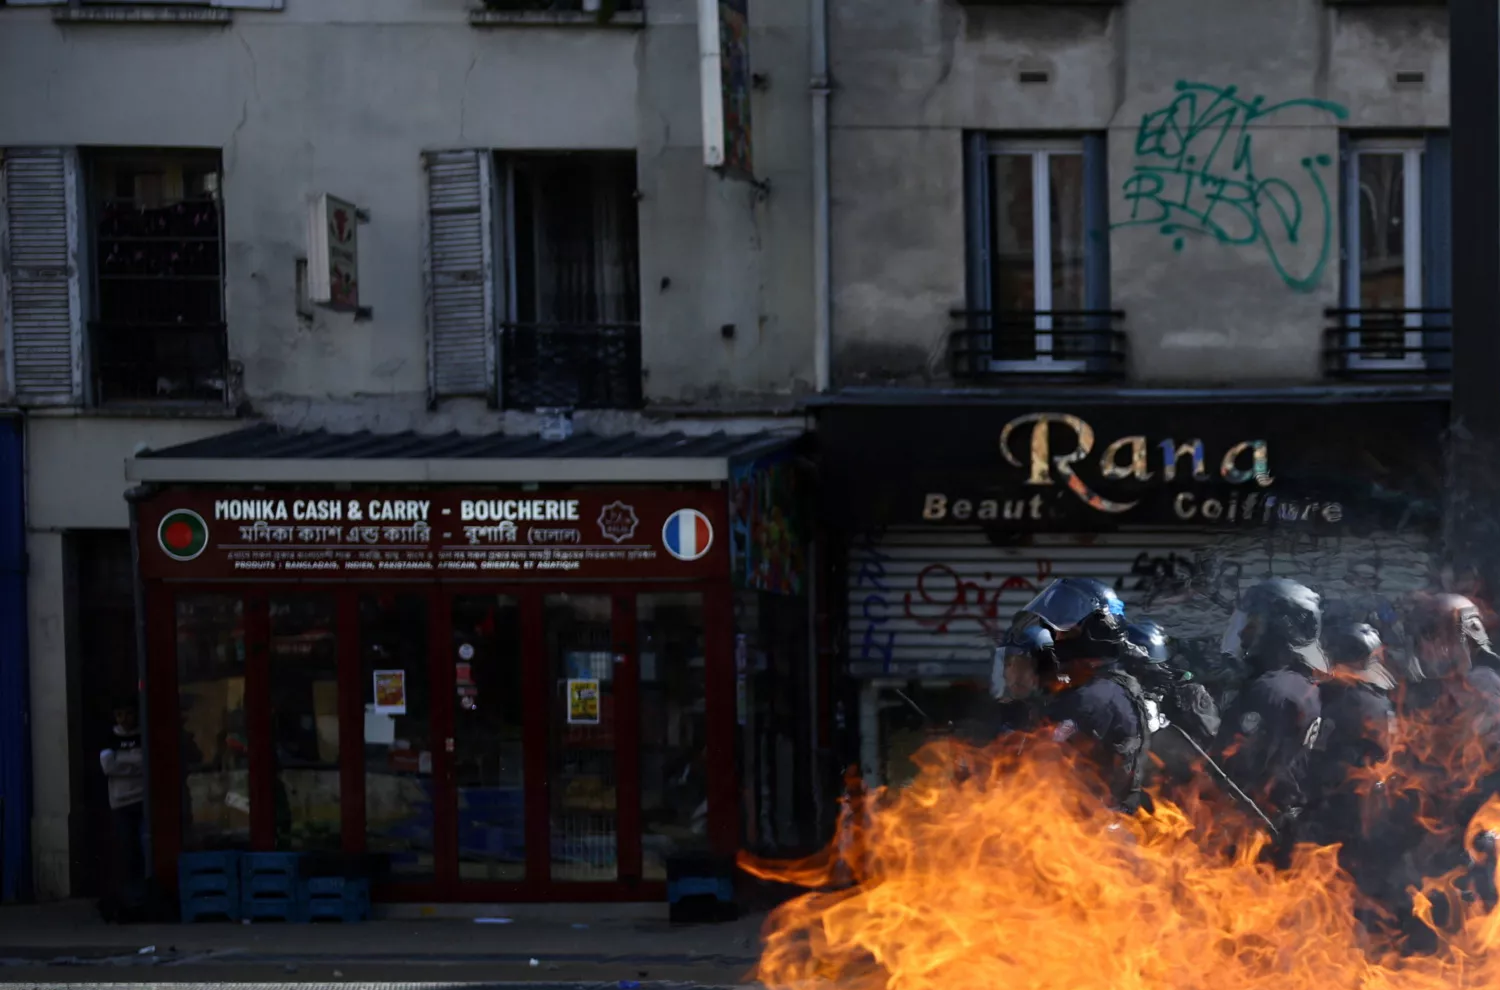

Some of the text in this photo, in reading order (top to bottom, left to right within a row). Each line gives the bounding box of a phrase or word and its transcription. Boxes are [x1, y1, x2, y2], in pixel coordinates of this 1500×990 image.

[999, 411, 1275, 514] Rana
[214, 499, 289, 521] MONIKA
[292, 499, 342, 521] CASH
[347, 499, 364, 521] &
[368, 499, 431, 521] CARRY
[461, 499, 580, 521] BOUCHERIE
[1175, 491, 1343, 523] Coiffure
[234, 560, 275, 570] PRODUITS
[480, 560, 520, 570] ORIENTAL
[536, 560, 581, 571] ASIATIQUE
